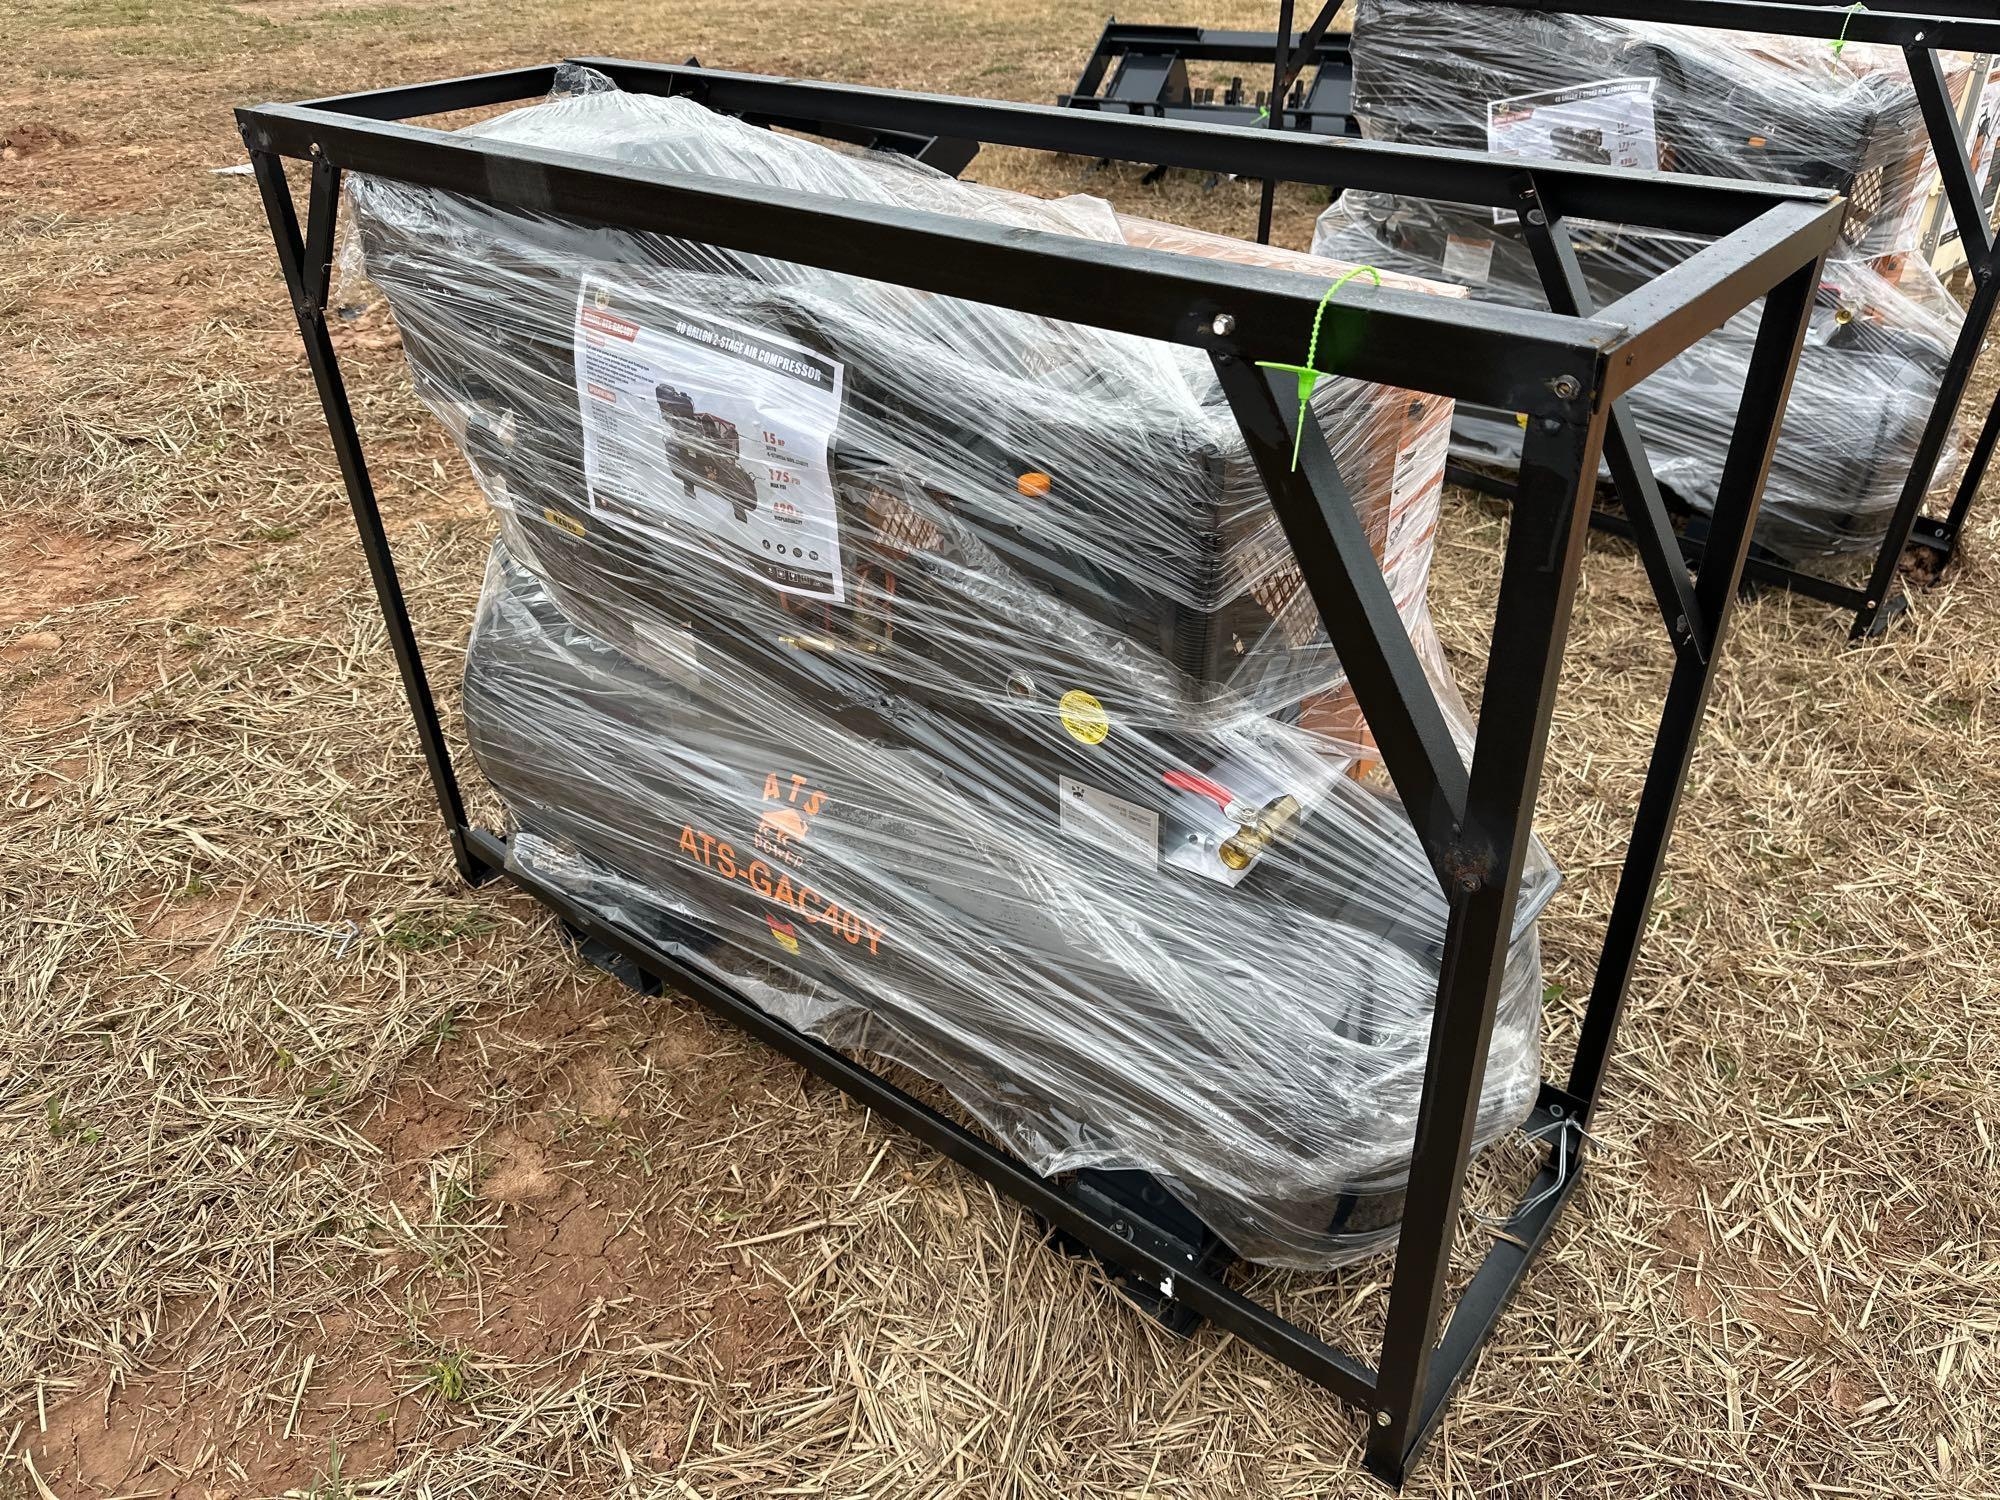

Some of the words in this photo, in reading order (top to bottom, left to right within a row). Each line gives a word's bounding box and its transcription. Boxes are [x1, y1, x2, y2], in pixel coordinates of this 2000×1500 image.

[675, 321, 687, 335] 40
[686, 322, 713, 344] GALLON
[712, 333, 744, 355] 2-STAGE
[743, 344, 760, 360] AIR
[758, 349, 822, 381] COMPRESSOR
[763, 431, 776, 445] 15
[769, 468, 790, 483] 175
[763, 772, 828, 815] ATS
[754, 834, 804, 868] POWER
[679, 824, 888, 956] ATS-GAC40Y
